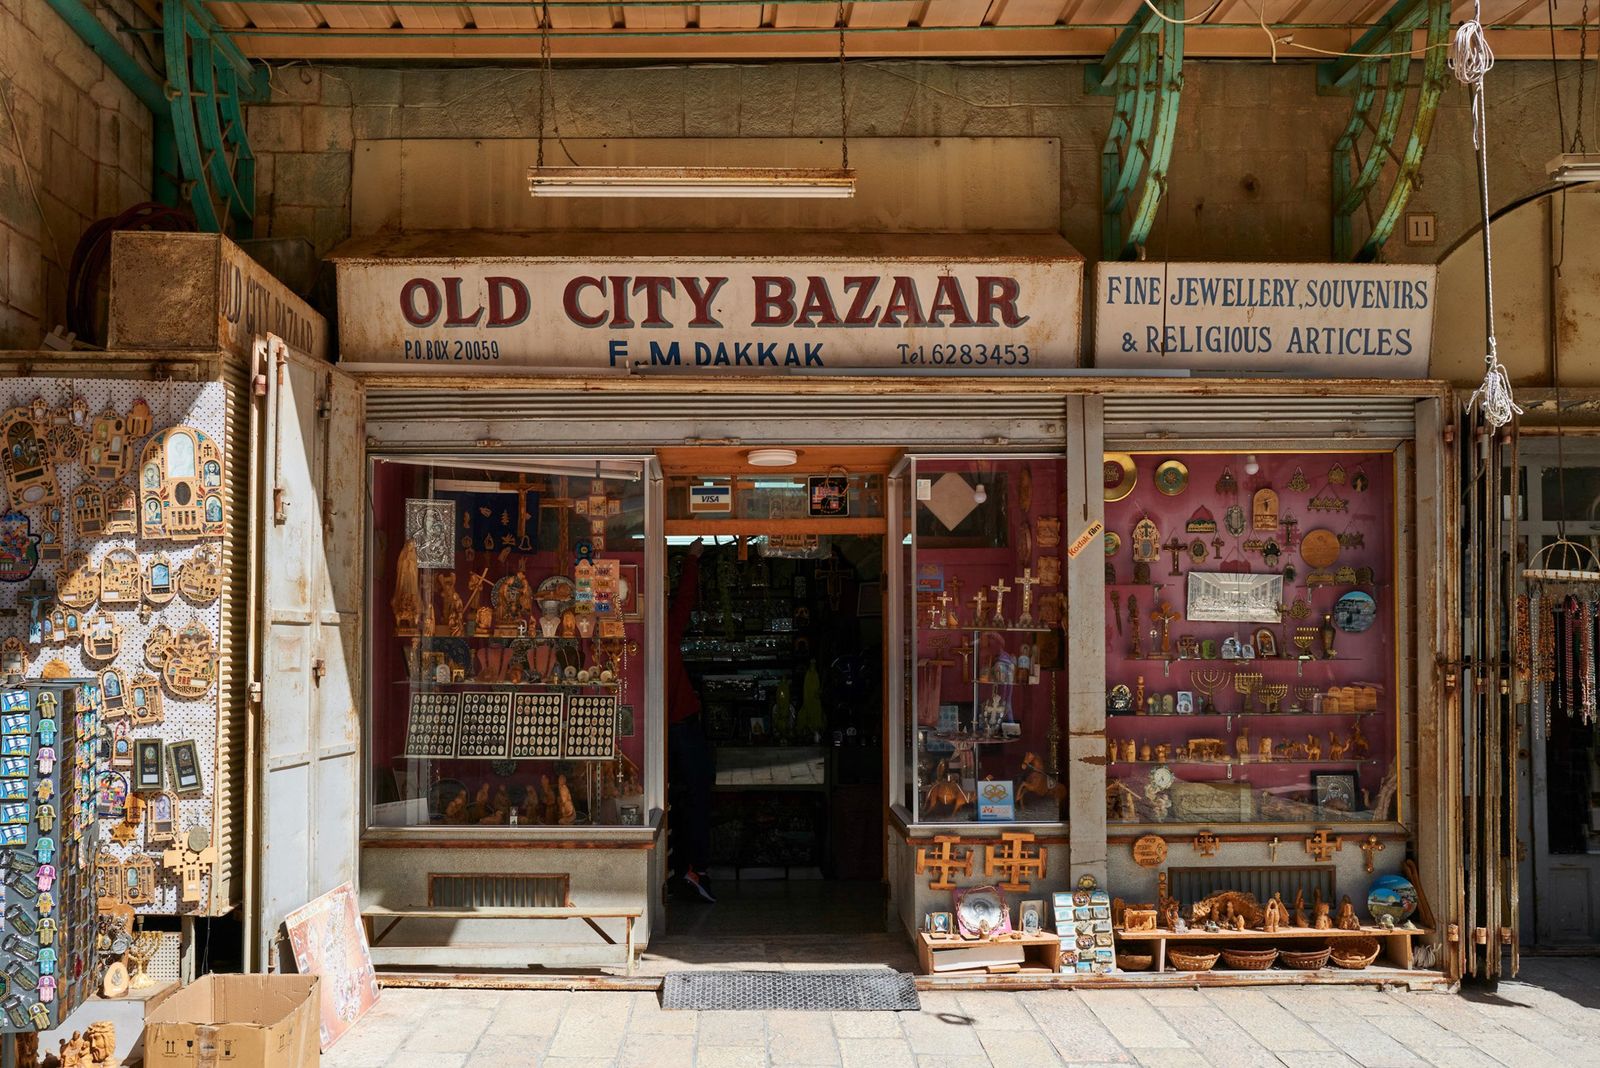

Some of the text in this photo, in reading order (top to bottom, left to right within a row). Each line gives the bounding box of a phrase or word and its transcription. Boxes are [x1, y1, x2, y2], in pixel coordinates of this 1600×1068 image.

[400, 275, 1031, 329] OLD CITY BAZAAR
[1107, 276, 1162, 306] FINE
[454, 340, 500, 361] 20059
[1122, 325, 1413, 357] & RELIGIOUS ARTICLES
[701, 495, 720, 503] VISA
[1068, 523, 1102, 557] Kodak film
